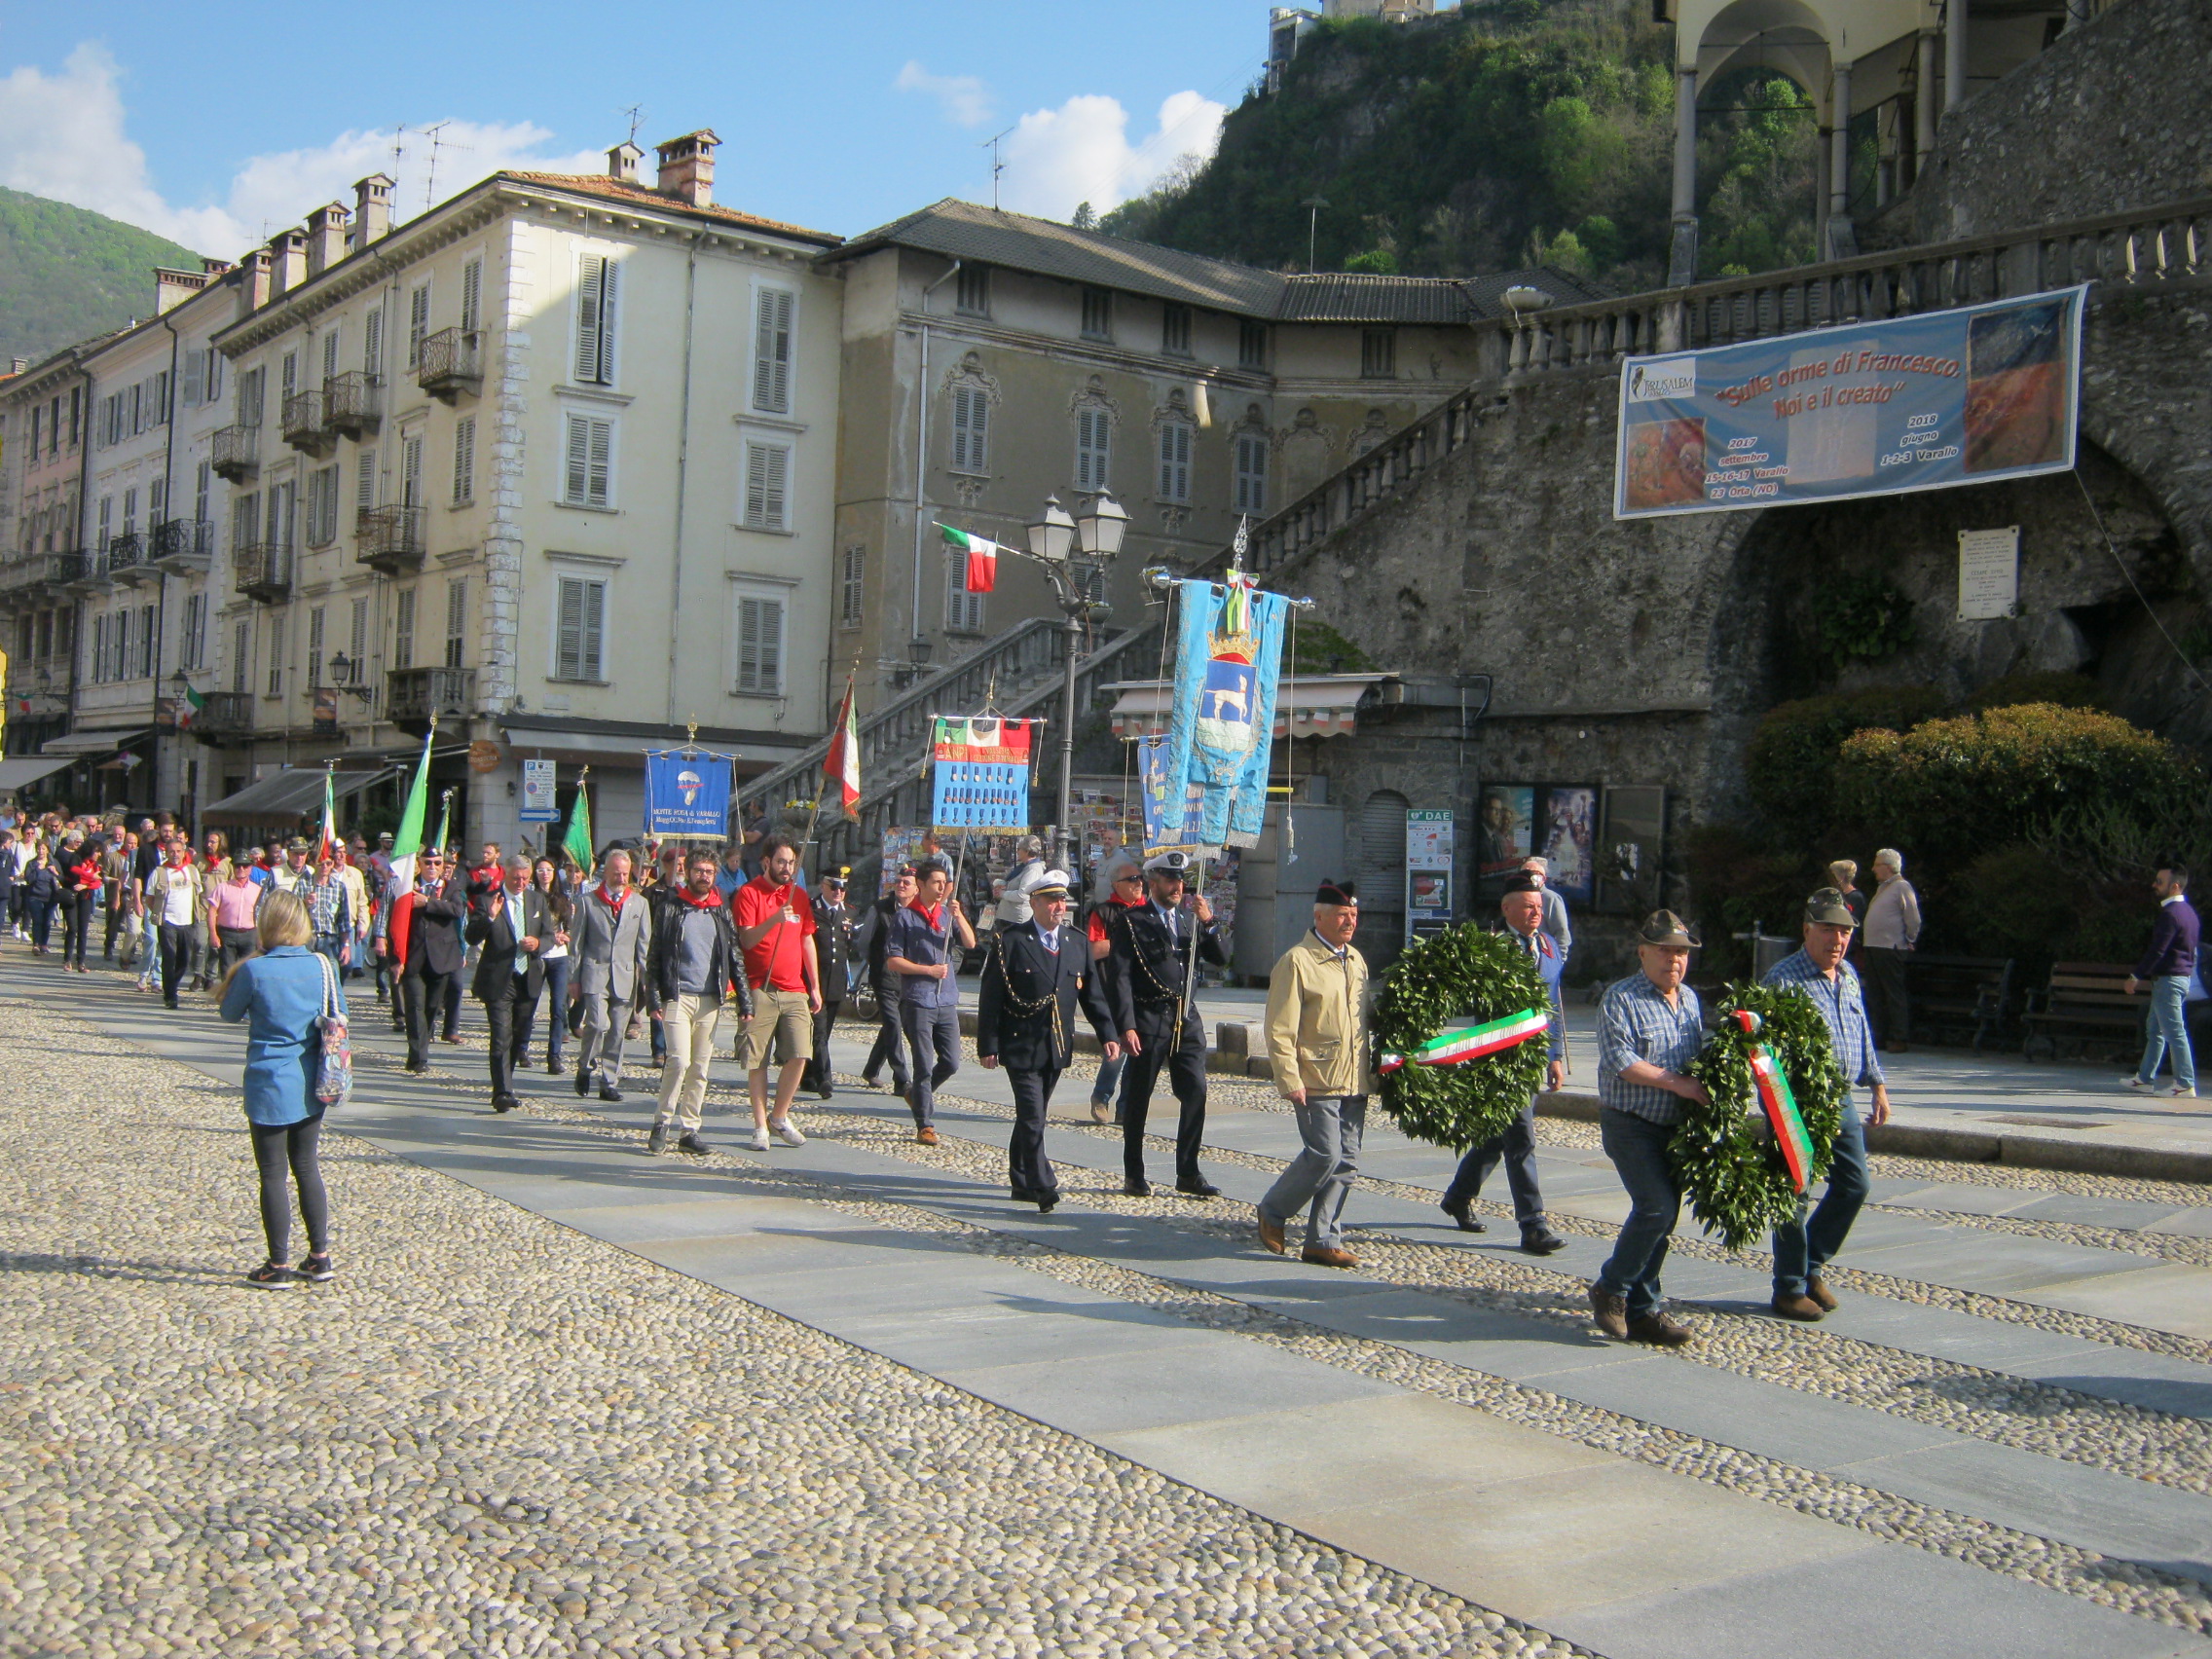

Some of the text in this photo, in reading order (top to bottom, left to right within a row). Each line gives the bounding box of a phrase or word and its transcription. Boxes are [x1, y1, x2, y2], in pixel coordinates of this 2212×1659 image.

[1778, 360, 1827, 387] orme
[1832, 350, 1853, 375] di
[1856, 350, 1961, 379] Francesco,
[1773, 395, 1801, 420] Noi
[1807, 396, 1817, 411] e
[1822, 385, 1833, 407] il
[1908, 414, 1937, 427] 2018
[1728, 437, 1757, 448] 2017
[1900, 431, 1938, 447] giugno
[1719, 453, 1768, 465] settembre
[1881, 447, 1958, 465] 1-2-3 Varallo
[1706, 466, 1789, 483] 15-16-17 Varallo
[1711, 483, 1779, 498] 23 Orta (NO)
[945, 746, 968, 760] ANPI
[1425, 812, 1451, 821] DAE
